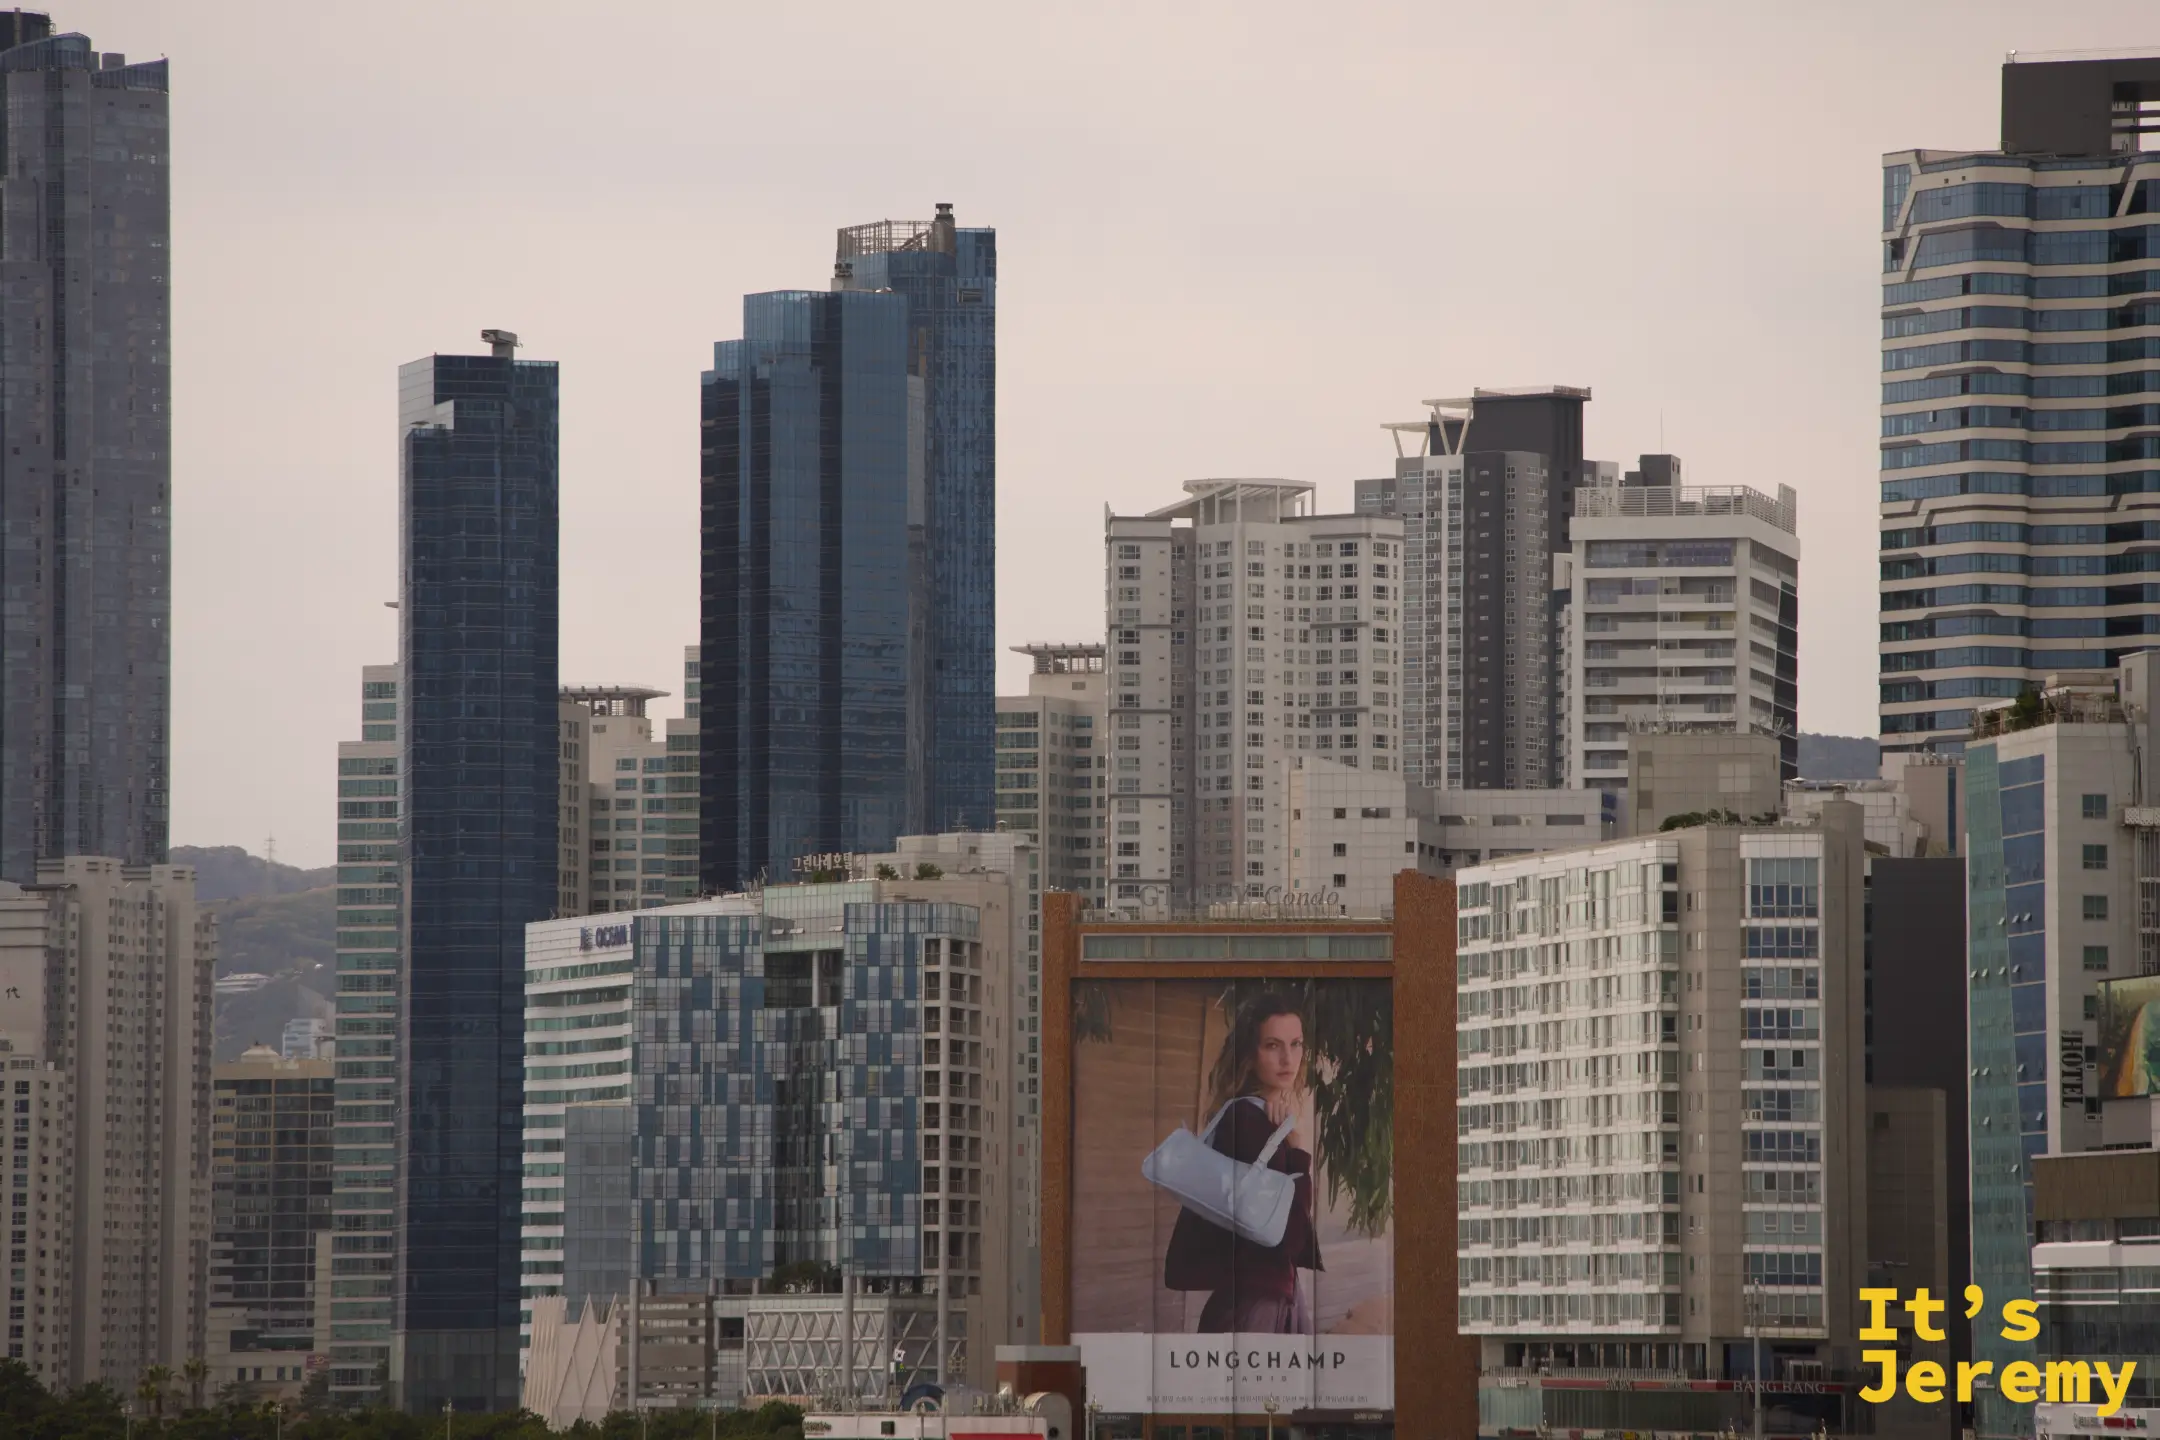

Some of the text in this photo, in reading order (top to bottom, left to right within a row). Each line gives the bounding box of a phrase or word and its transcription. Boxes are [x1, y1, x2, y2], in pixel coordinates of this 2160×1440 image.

[1264, 885, 1340, 906] Condo
[596, 925, 627, 948] OCEAN
[2061, 1035, 2084, 1108] HOTEL
[1170, 1350, 1346, 1370] LONGCHAMP
[1226, 1375, 1288, 1383] PARIS
[1733, 1381, 1826, 1394] BANG BANG
